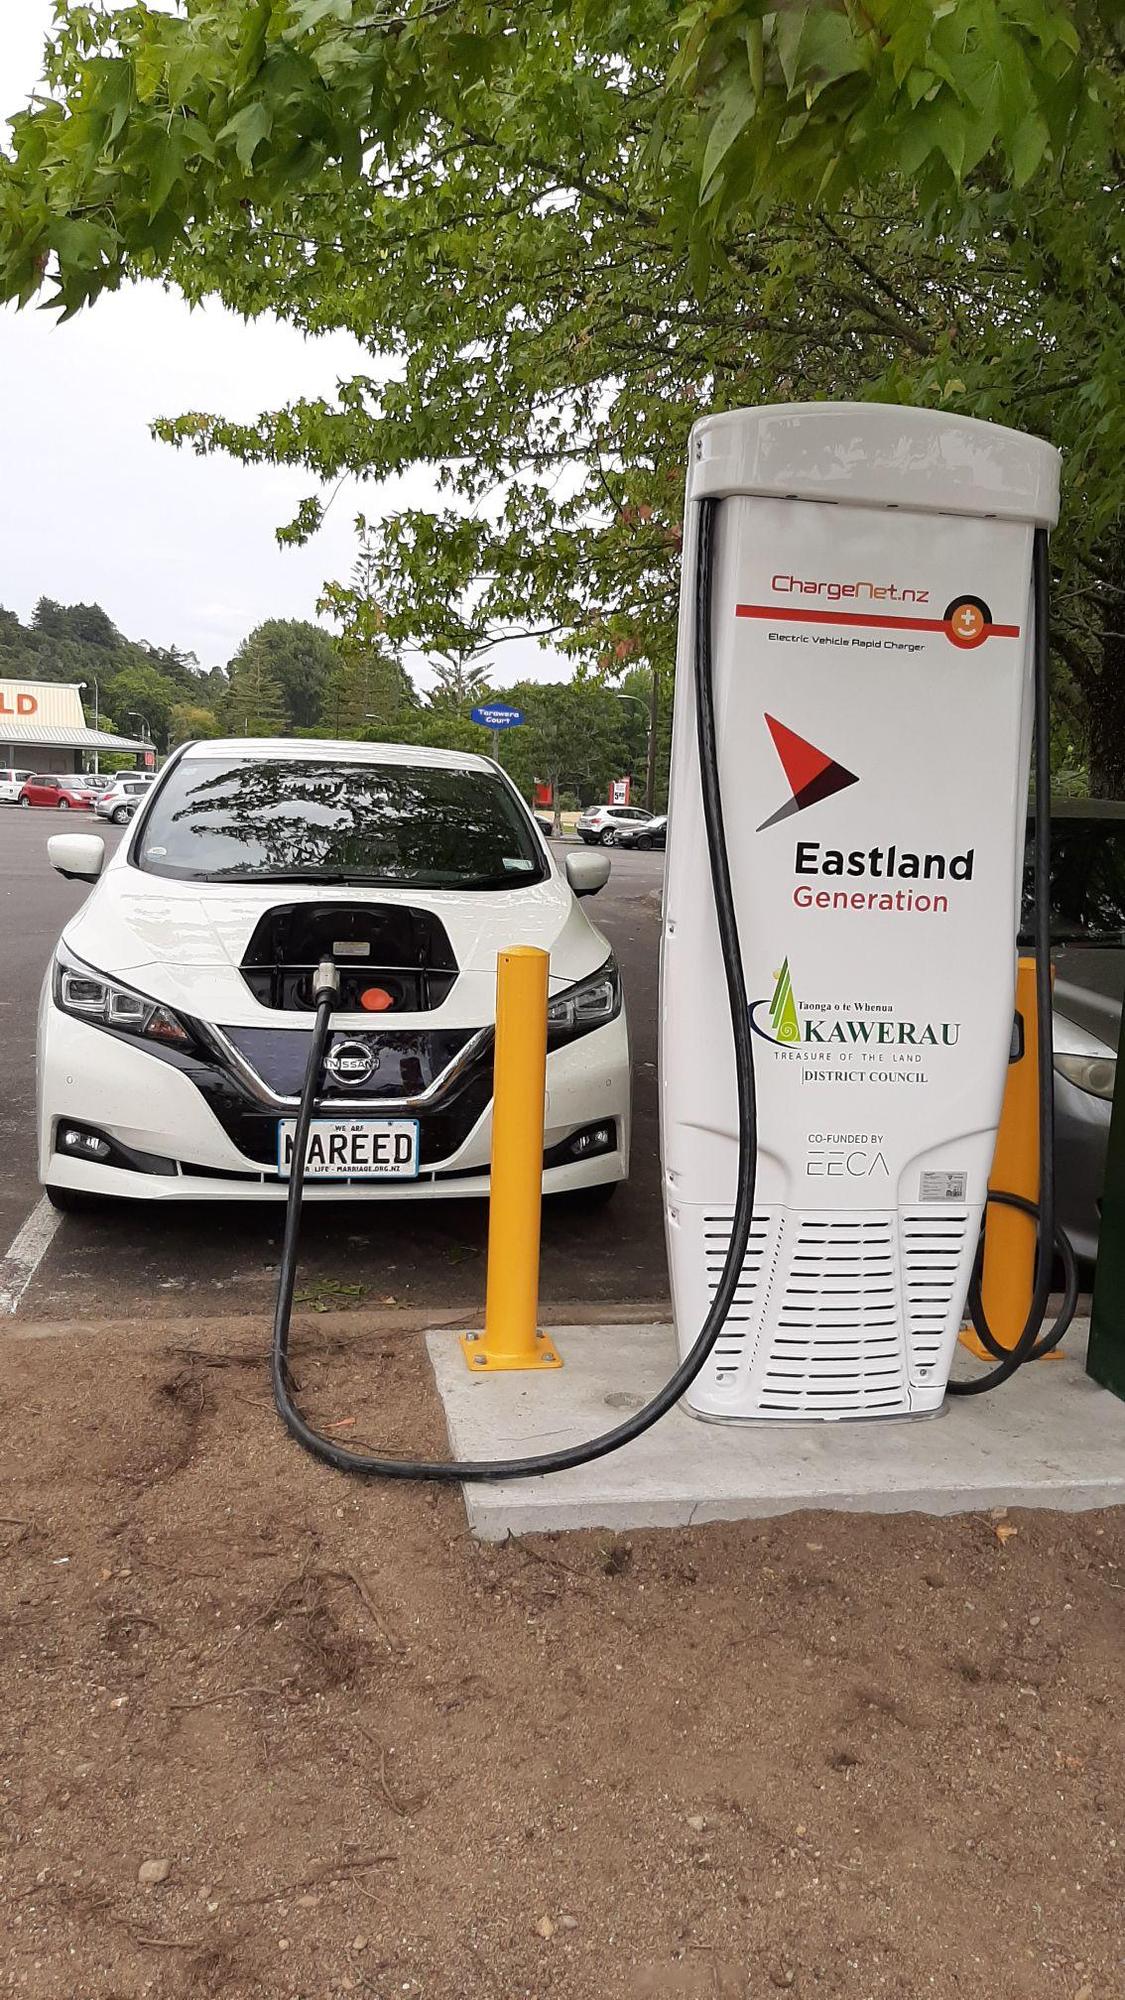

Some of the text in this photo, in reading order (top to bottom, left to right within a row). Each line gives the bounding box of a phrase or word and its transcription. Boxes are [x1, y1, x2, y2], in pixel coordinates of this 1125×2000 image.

[772, 575, 929, 603] ChargeNet.nz
[768, 633, 925, 652] Electric Vehicle Rapid Charger
[486, 716, 510, 724] Court
[795, 842, 974, 880] Eastland
[793, 886, 948, 912] Generation
[799, 1001, 831, 1012] Taonga
[843, 1003, 851, 1011] te
[854, 1002, 893, 1012] Whenua
[803, 1020, 961, 1046] KAWERAU
[325, 1058, 378, 1069] NISSAN
[775, 1052, 922, 1063] TREASURE OF THE LAND
[804, 1070, 928, 1083] DISTRICT COUNCIL
[808, 1134, 884, 1144] CO-FUNDED BY
[806, 1151, 890, 1177] EECA
